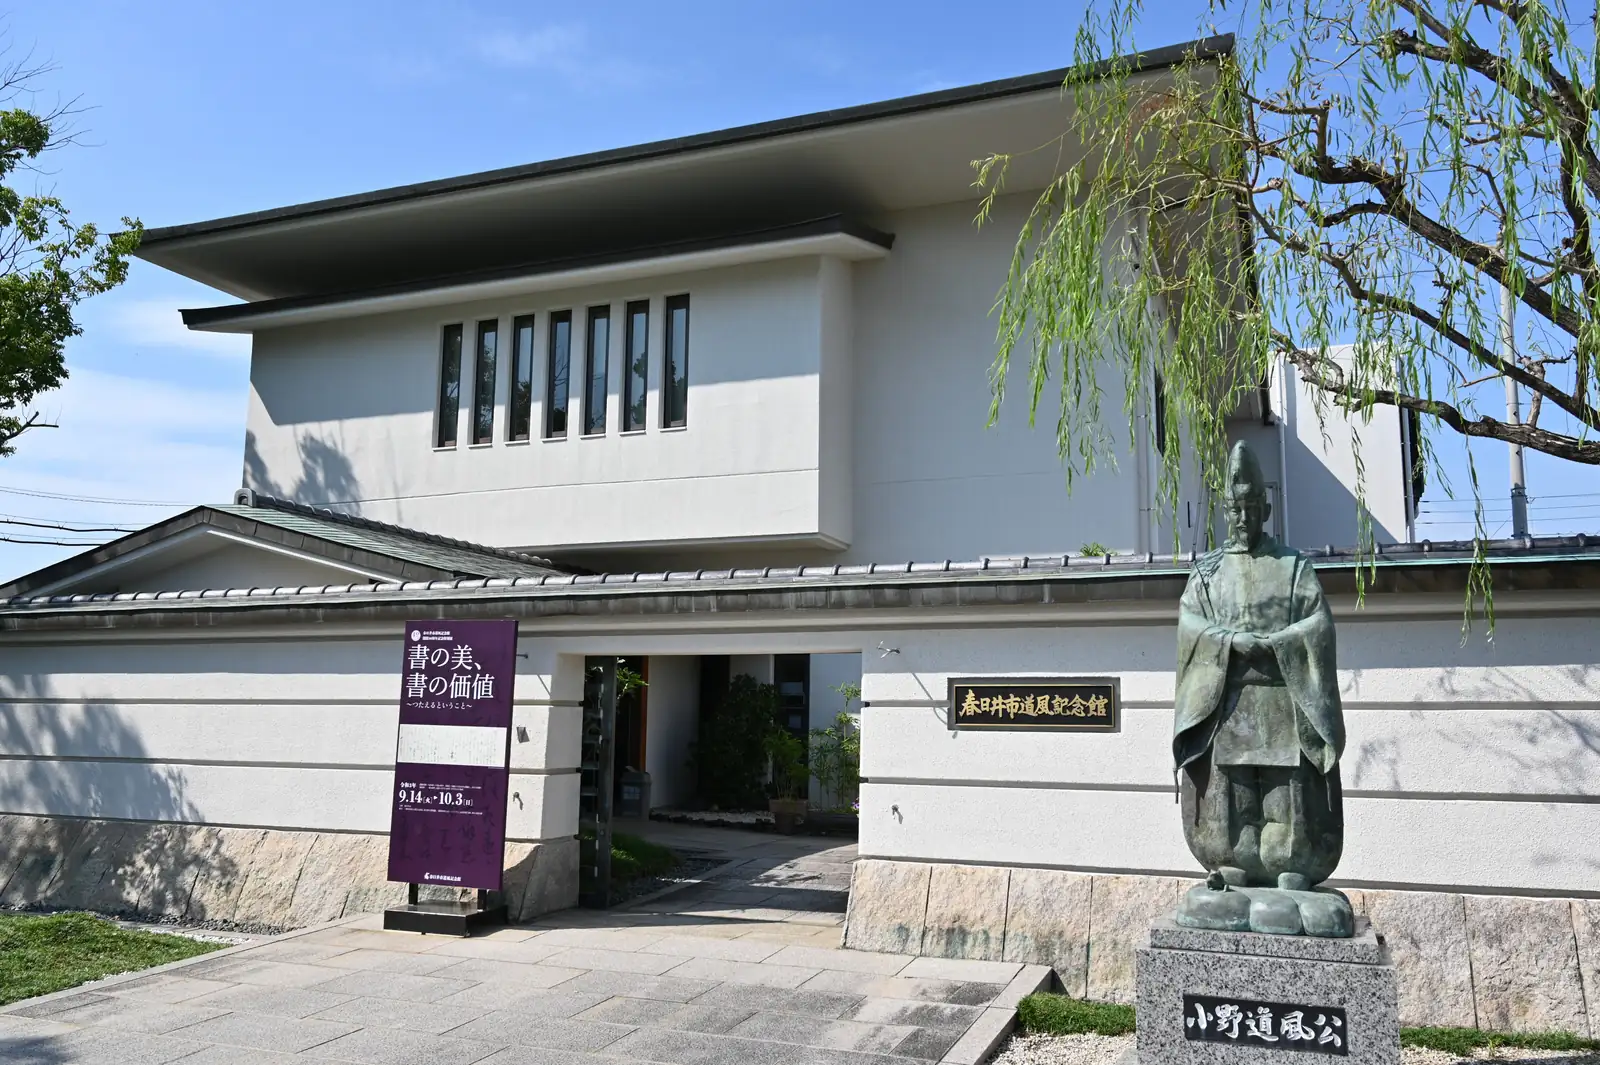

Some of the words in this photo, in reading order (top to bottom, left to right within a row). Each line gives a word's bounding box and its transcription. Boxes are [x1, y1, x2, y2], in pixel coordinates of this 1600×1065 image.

[408, 644, 481, 670] 書の美、
[406, 672, 495, 700] 書の価値
[959, 689, 1109, 719] 春日井市道風記念館
[1186, 1003, 1342, 1047] 小野道風公
